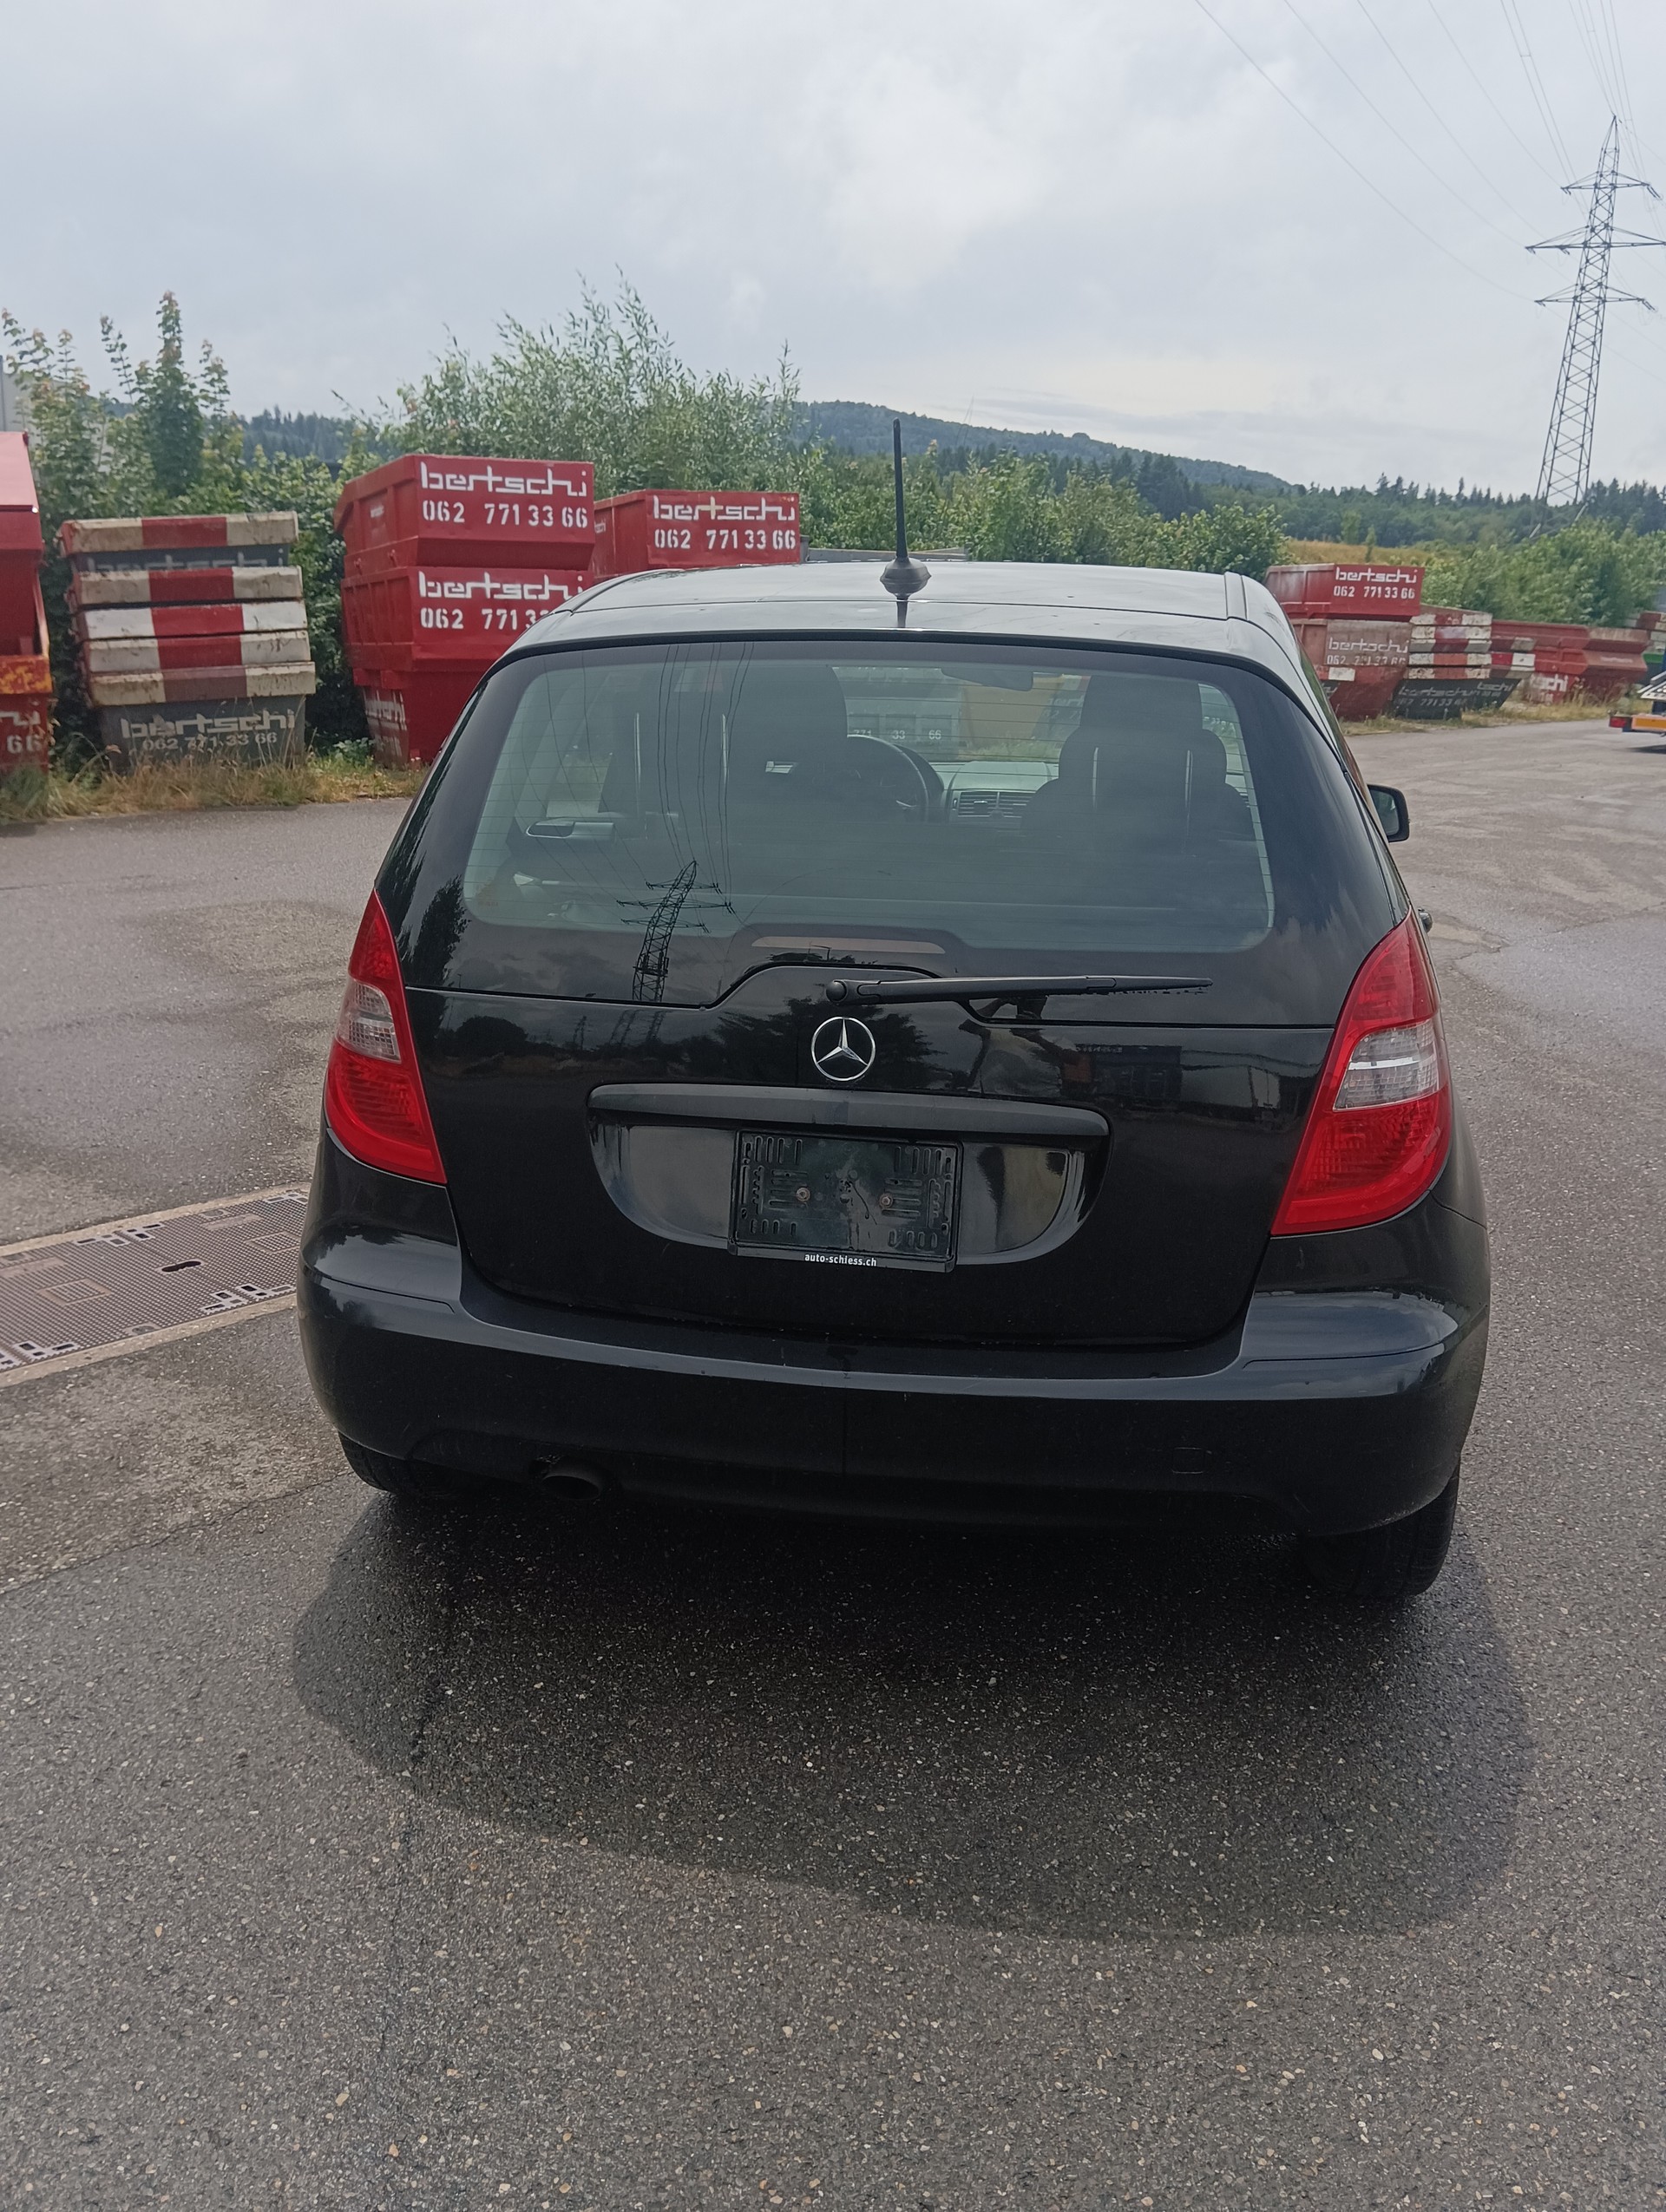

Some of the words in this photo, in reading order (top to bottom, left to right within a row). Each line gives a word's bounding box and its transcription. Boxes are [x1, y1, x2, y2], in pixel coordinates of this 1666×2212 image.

[421, 461, 587, 497] bertschi
[423, 501, 465, 523] 062
[484, 503, 520, 526] 771
[528, 505, 554, 527] 33
[561, 507, 588, 528] 66
[653, 494, 796, 521] bertschi
[654, 528, 692, 549] 062
[706, 529, 738, 549] 771
[744, 530, 766, 550] 33
[772, 530, 797, 550] 66
[1335, 566, 1417, 584] bertschi
[1334, 586, 1355, 598] 062
[1363, 586, 1381, 599] 771
[1384, 586, 1399, 599] 33
[1400, 587, 1416, 599] 66
[420, 607, 464, 630] 062
[482, 608, 517, 631] 771
[1328, 637, 1410, 654] bertschi
[6, 735, 43, 754] 66
[142, 737, 179, 751] 062
[254, 731, 278, 743] 66
[892, 730, 907, 740] 33
[928, 730, 942, 740] 66
[804, 1253, 876, 1266] auto-schiess.ch
